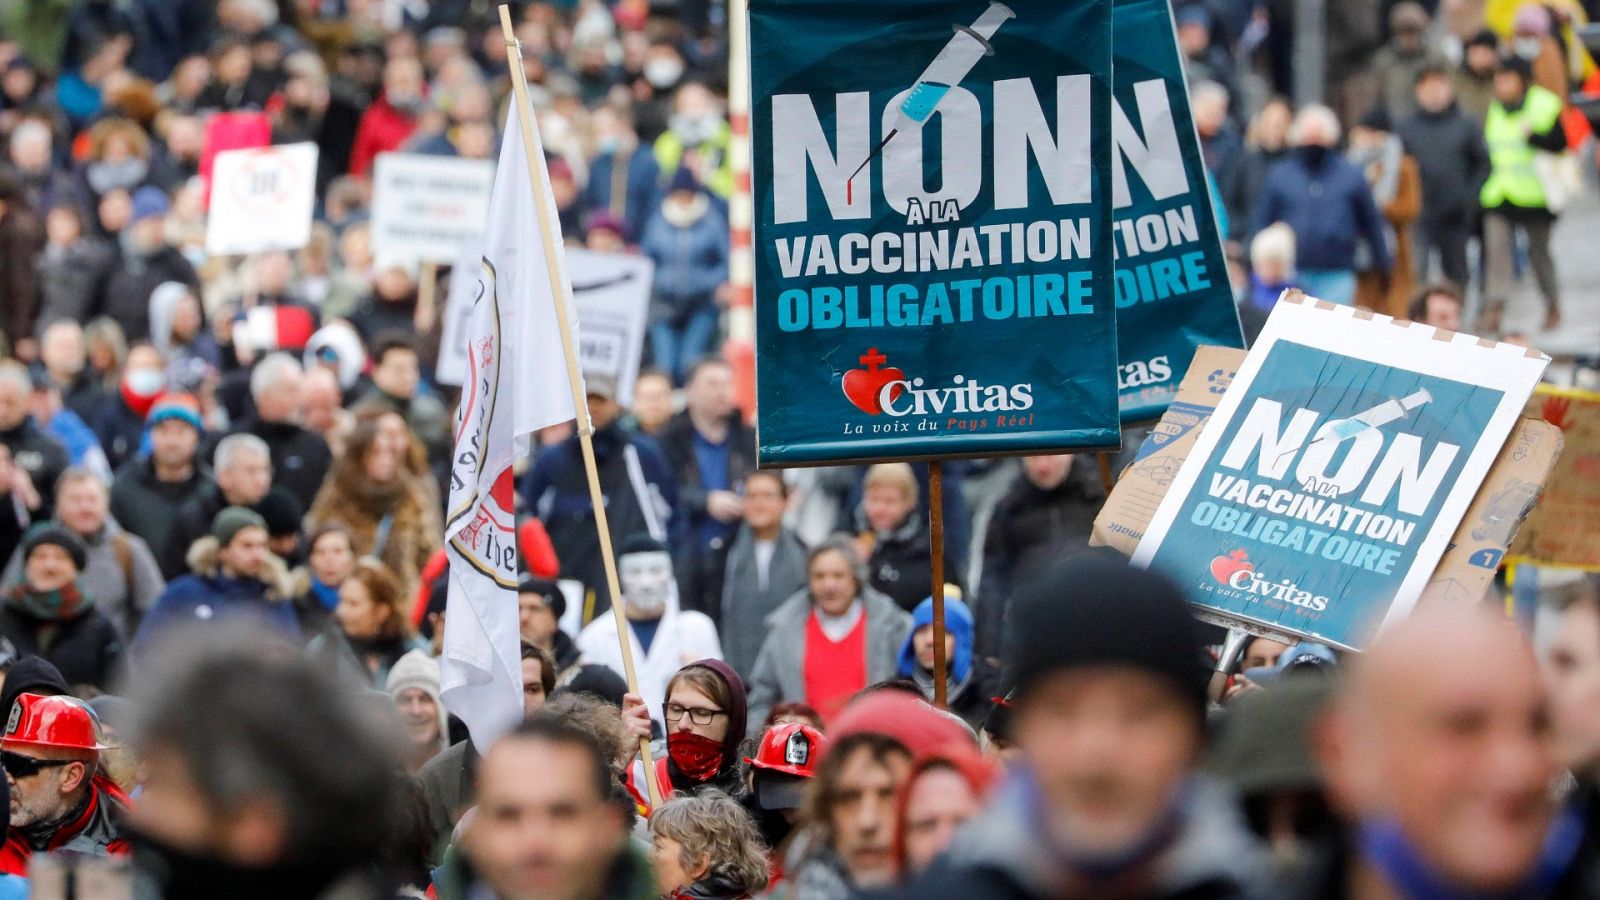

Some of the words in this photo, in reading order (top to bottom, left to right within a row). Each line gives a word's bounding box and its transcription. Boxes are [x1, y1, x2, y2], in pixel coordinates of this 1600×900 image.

[771, 73, 1093, 225] NON
[906, 200, 923, 226] À
[930, 200, 960, 224] LA
[775, 217, 1092, 278] VACCINATION
[777, 271, 1095, 332] OBLIGATOIRE
[843, 422, 864, 434] La
[872, 421, 910, 433] voix
[917, 419, 938, 431] du
[947, 417, 988, 432] Pays
[996, 414, 1035, 427] Réel
[879, 374, 1034, 417] Civitas
[1219, 397, 1461, 517] NON
[1190, 501, 1401, 576] OBLIGATOIRE
[1208, 472, 1416, 546] VACCINATION
[1229, 569, 1329, 611] Civitas
